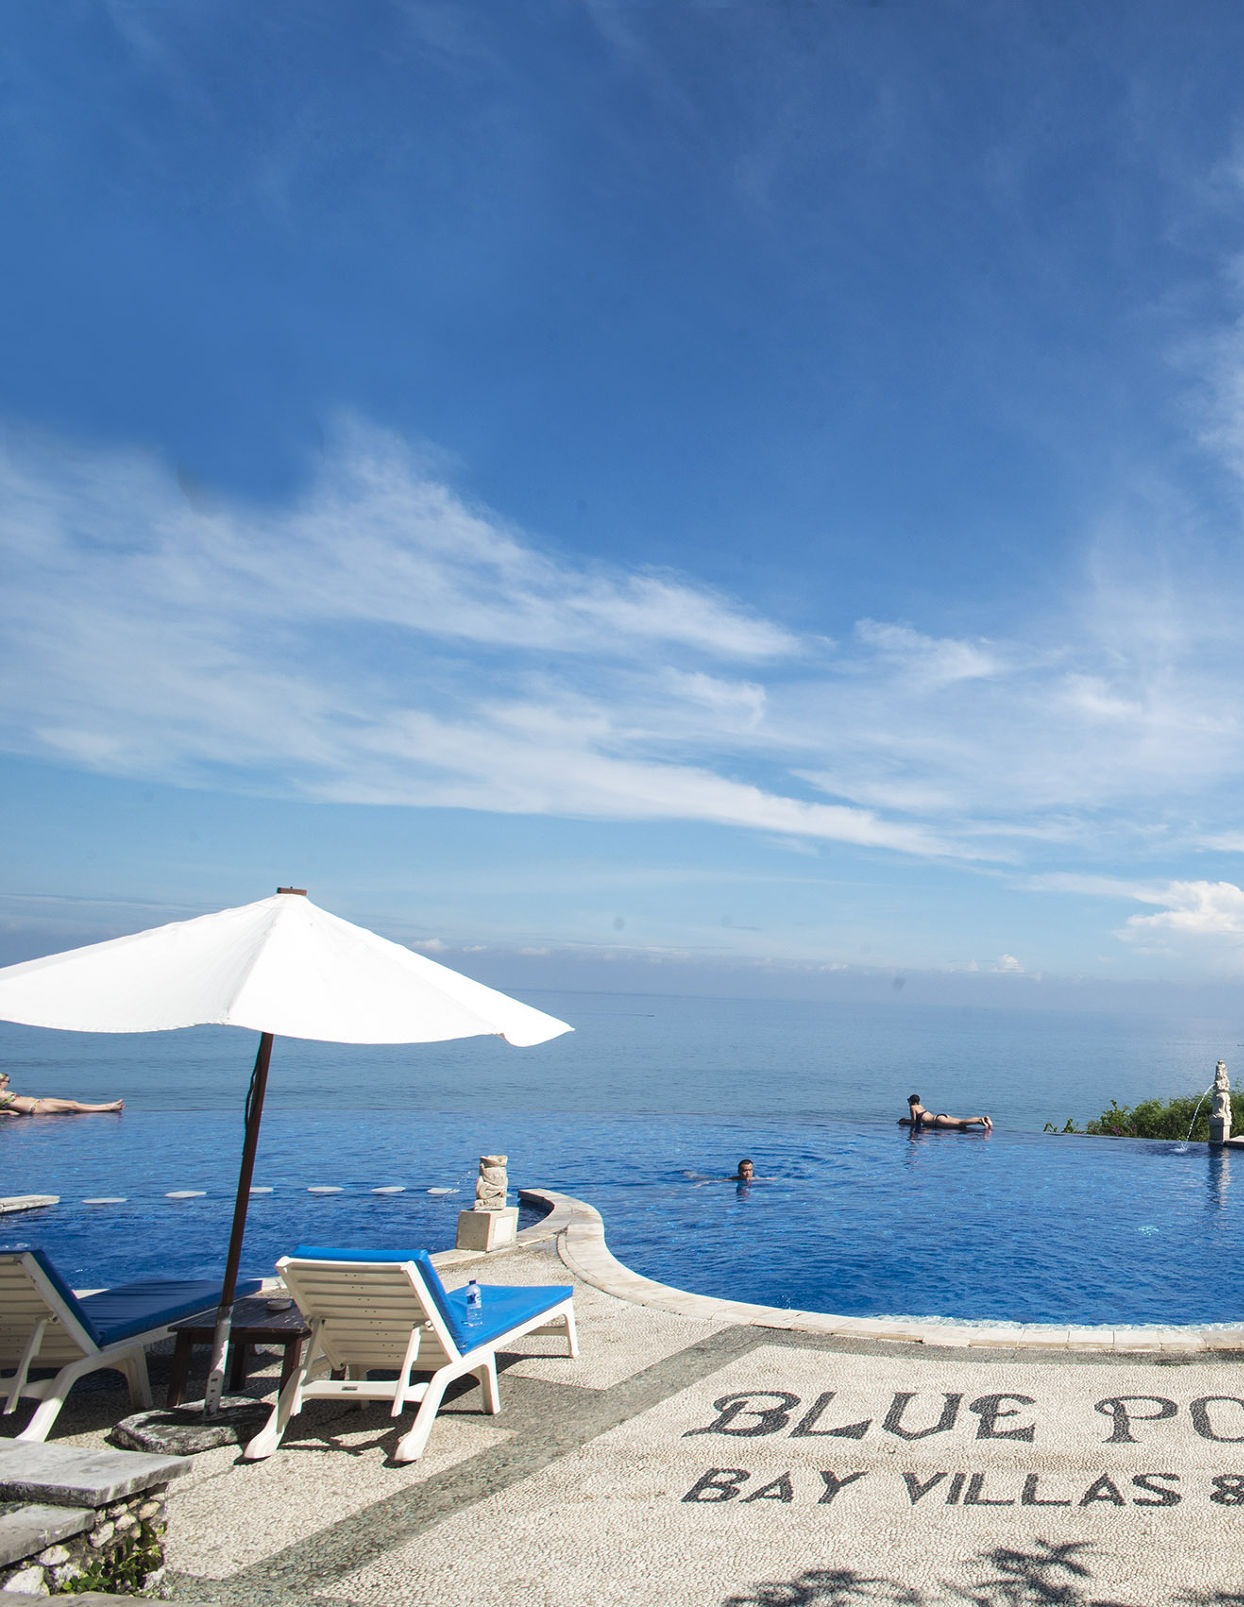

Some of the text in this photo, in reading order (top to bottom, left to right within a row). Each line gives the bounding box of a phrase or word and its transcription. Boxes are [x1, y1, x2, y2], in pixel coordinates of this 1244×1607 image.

[681, 1390, 1036, 1442] BLUE
[680, 1467, 869, 1504] BAY
[901, 1472, 1182, 1507] VILLAS
